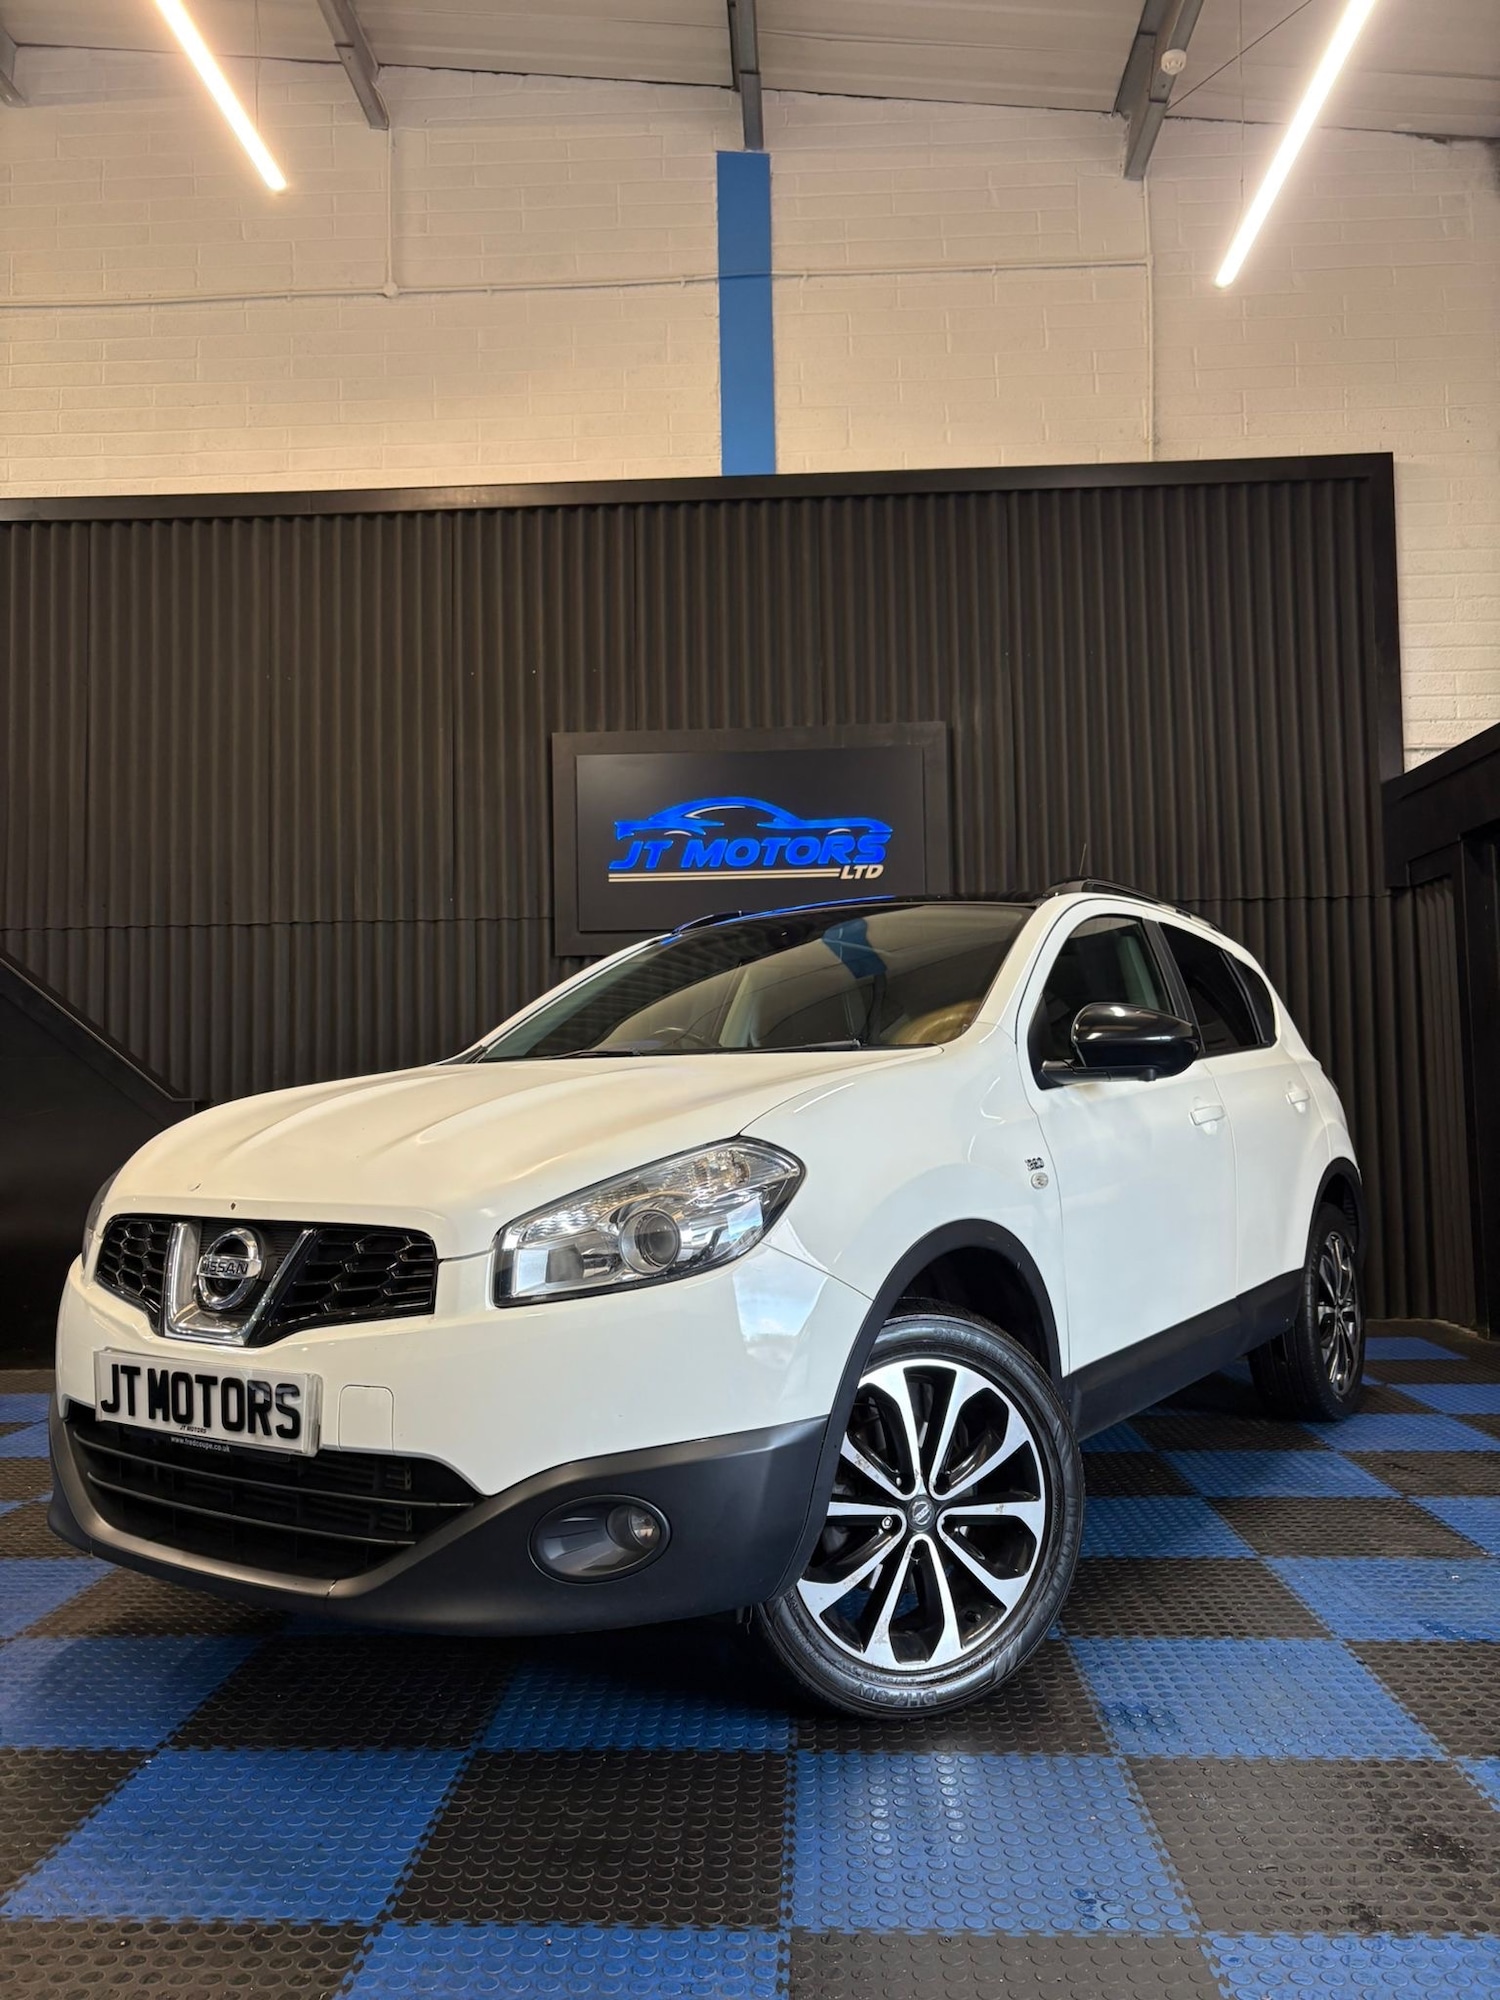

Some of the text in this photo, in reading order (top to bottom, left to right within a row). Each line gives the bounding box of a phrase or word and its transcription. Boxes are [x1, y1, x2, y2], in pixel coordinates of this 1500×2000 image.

[609, 834, 892, 869] JT MOTORS
[840, 864, 884, 880] LTD
[101, 1363, 300, 1439] JT MOTORS
